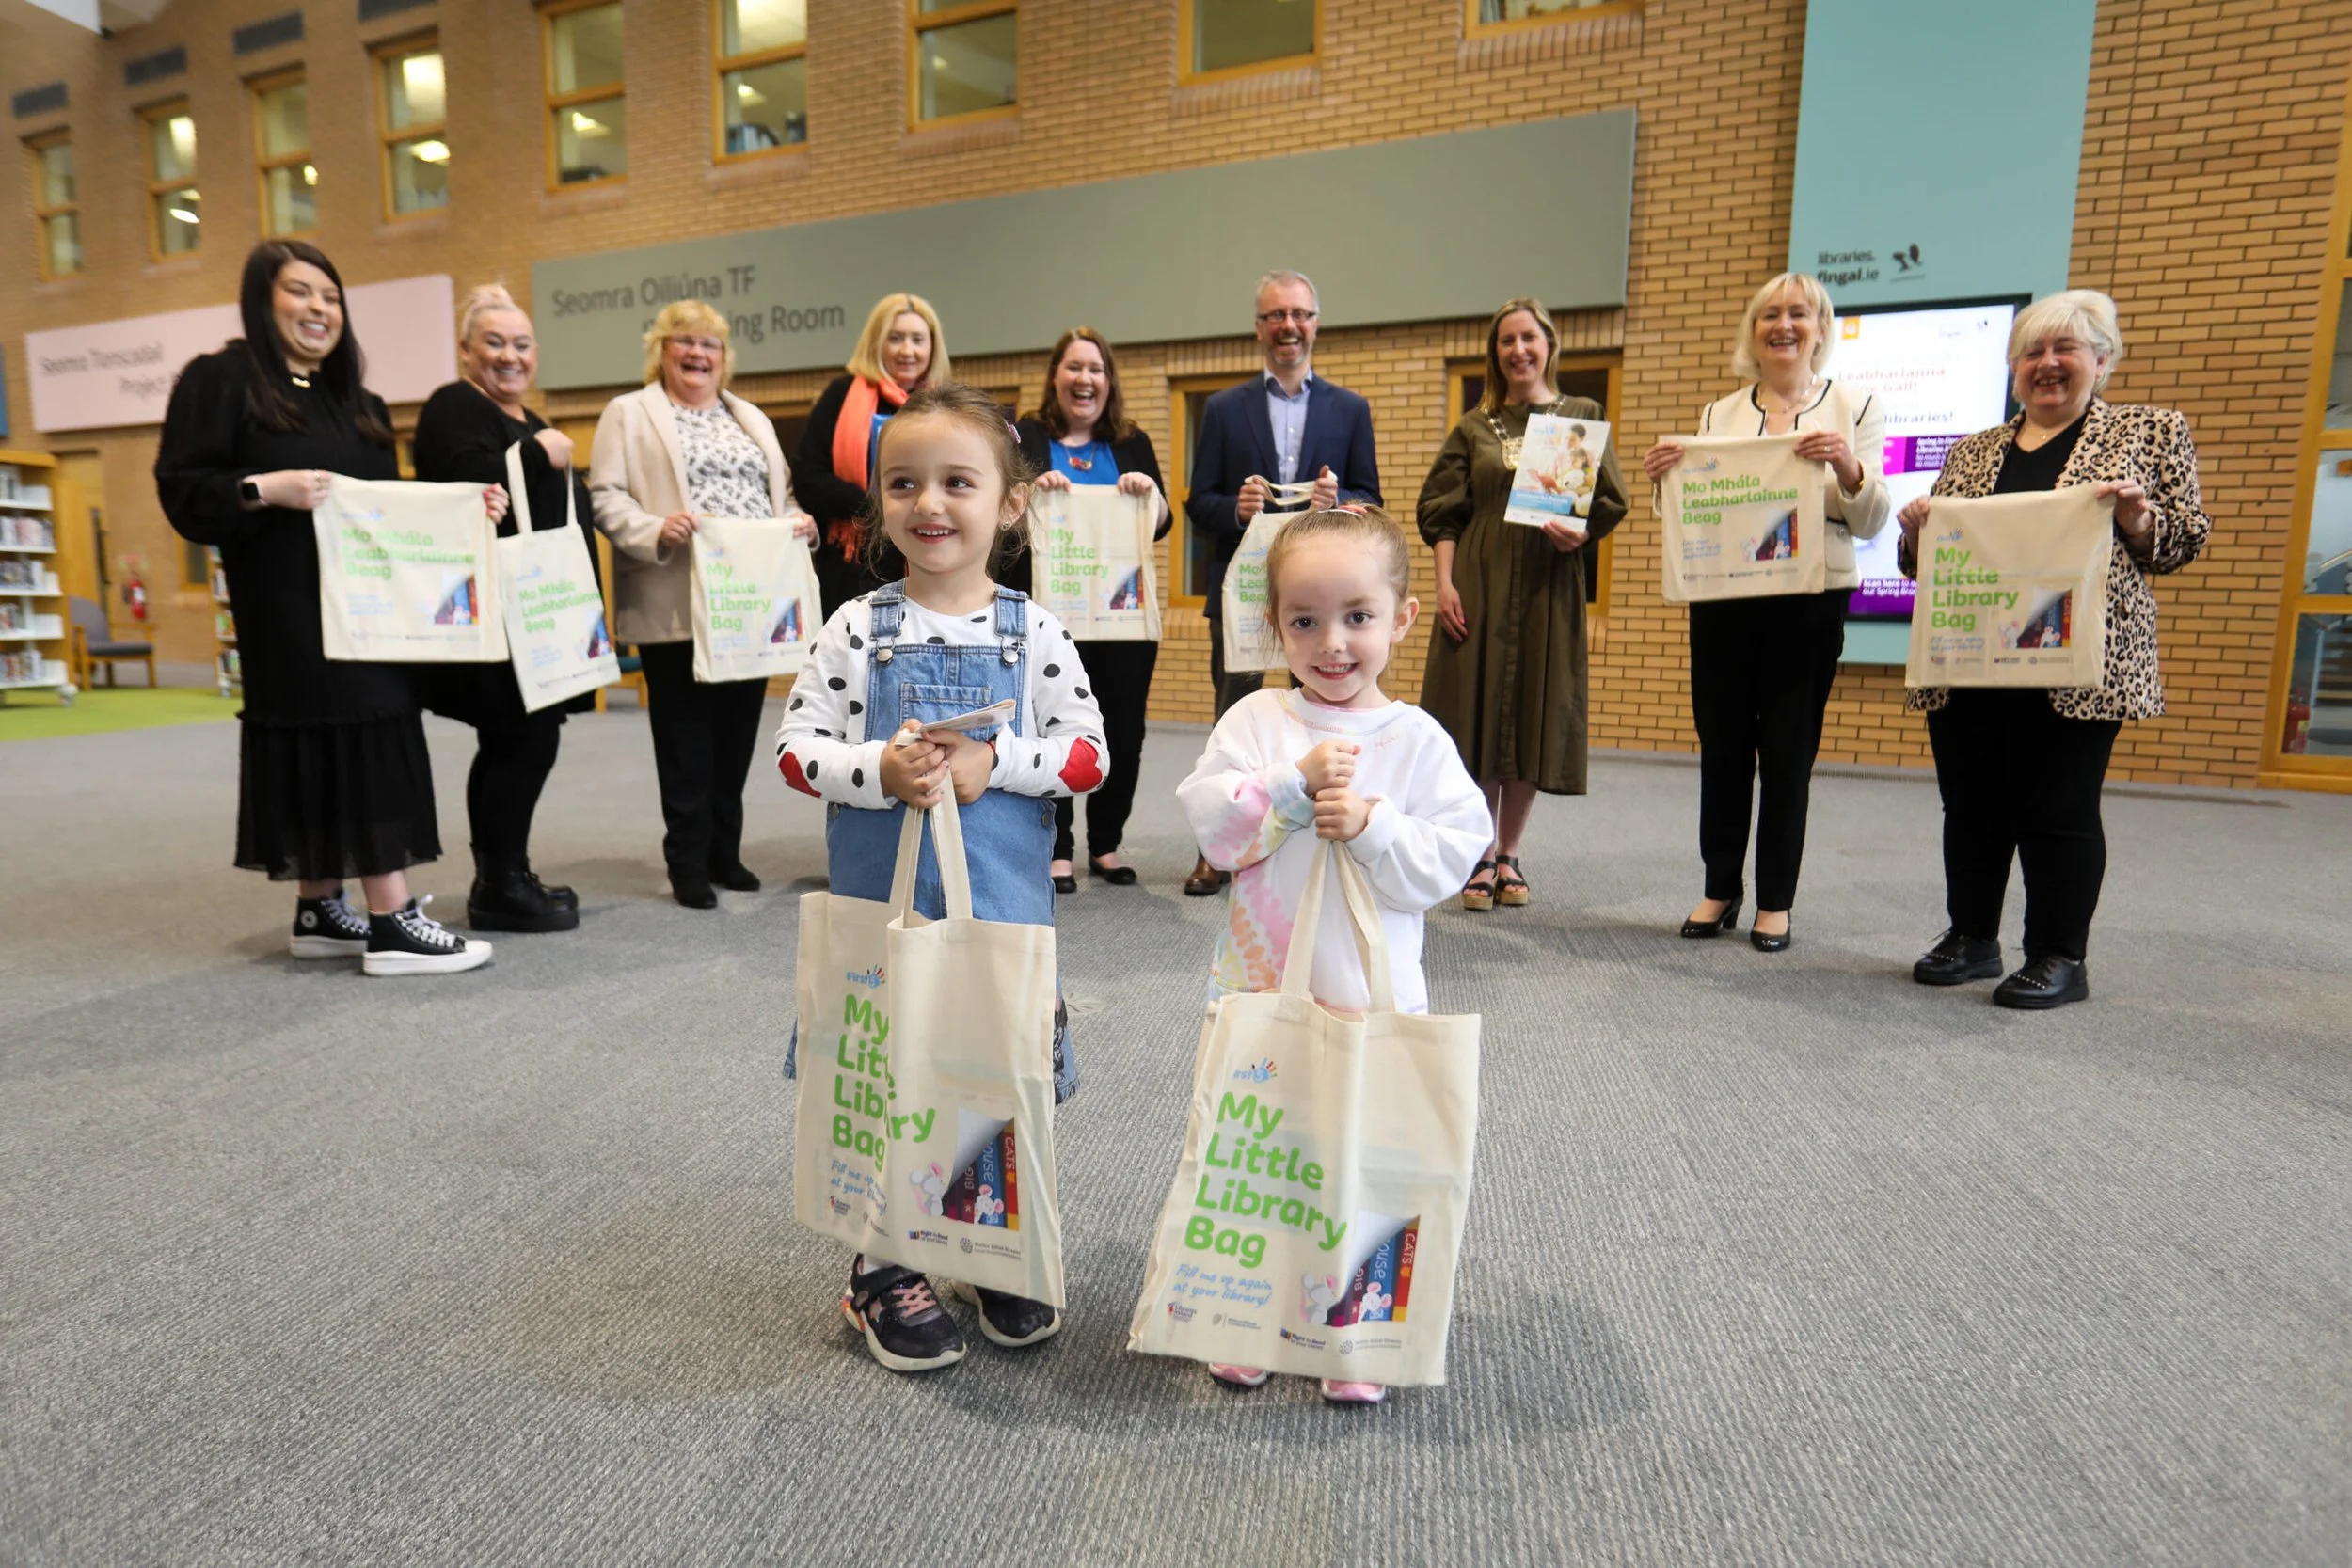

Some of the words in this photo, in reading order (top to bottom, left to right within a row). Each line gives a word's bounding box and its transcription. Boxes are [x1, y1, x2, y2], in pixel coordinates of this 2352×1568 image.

[1818, 249, 1876, 265] libraries.
[1817, 267, 1880, 286] fingal.ie
[552, 288, 634, 317] Seomra
[641, 271, 723, 307] Oiliúna
[726, 264, 756, 295] TF
[771, 303, 845, 334] Room
[1682, 481, 1707, 495] Mo
[1710, 474, 1761, 492] Mhála
[1682, 488, 1798, 510] Leabharlainne
[1682, 511, 1722, 525] Beag
[1050, 528, 1074, 545] My
[1050, 546, 1096, 559] Little
[1934, 546, 1971, 568] My
[707, 562, 734, 579] My
[1050, 562, 1109, 579] Library
[1933, 567, 1999, 586] Little
[1051, 578, 1082, 596] Bag
[709, 597, 771, 614] Library
[1932, 589, 2019, 610] Library
[711, 615, 743, 633] Bag
[1931, 611, 1977, 632] Bag
[844, 993, 889, 1045] My
[1217, 1091, 1284, 1141] My
[833, 1114, 886, 1172] Bag
[1004, 1136, 1015, 1169] CATS
[1205, 1132, 1325, 1190] Little
[964, 1167, 975, 1190] BIG
[1195, 1174, 1347, 1251] Library
[1184, 1215, 1266, 1268] Bag
[1402, 1232, 1416, 1265] CATS
[1176, 1263, 1200, 1278] Fill
[1200, 1272, 1217, 1283] me
[1221, 1275, 1235, 1289] up
[1238, 1278, 1272, 1291] again
[1355, 1267, 1364, 1291] BIG
[1173, 1282, 1189, 1293] at
[1190, 1285, 1220, 1299] your
[1222, 1286, 1272, 1309] library!
